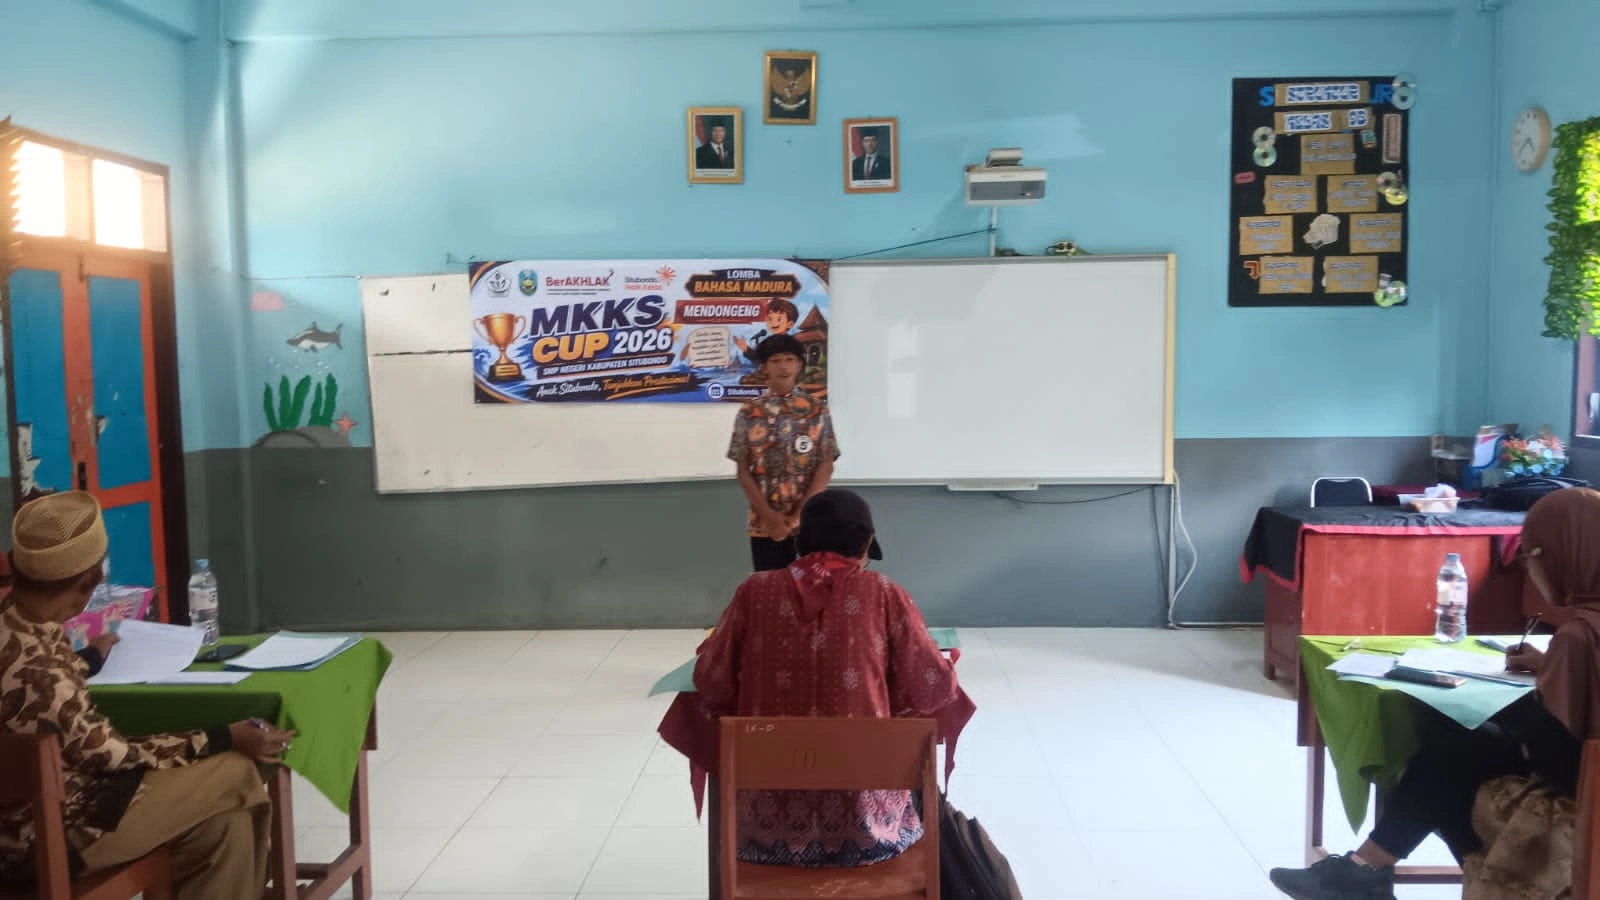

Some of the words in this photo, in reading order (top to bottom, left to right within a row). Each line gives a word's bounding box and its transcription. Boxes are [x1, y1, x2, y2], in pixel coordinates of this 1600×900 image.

[727, 270, 761, 279] LOMBA
[546, 275, 610, 287] BerAKHLAK
[694, 281, 740, 293] BAHASA
[743, 281, 793, 293] MADURA
[530, 295, 665, 337] MKKS
[683, 305, 760, 317] MENDONGENG
[532, 332, 609, 363] CUP
[612, 328, 673, 355] 2026
[587, 361, 627, 371] KABUPATEN
